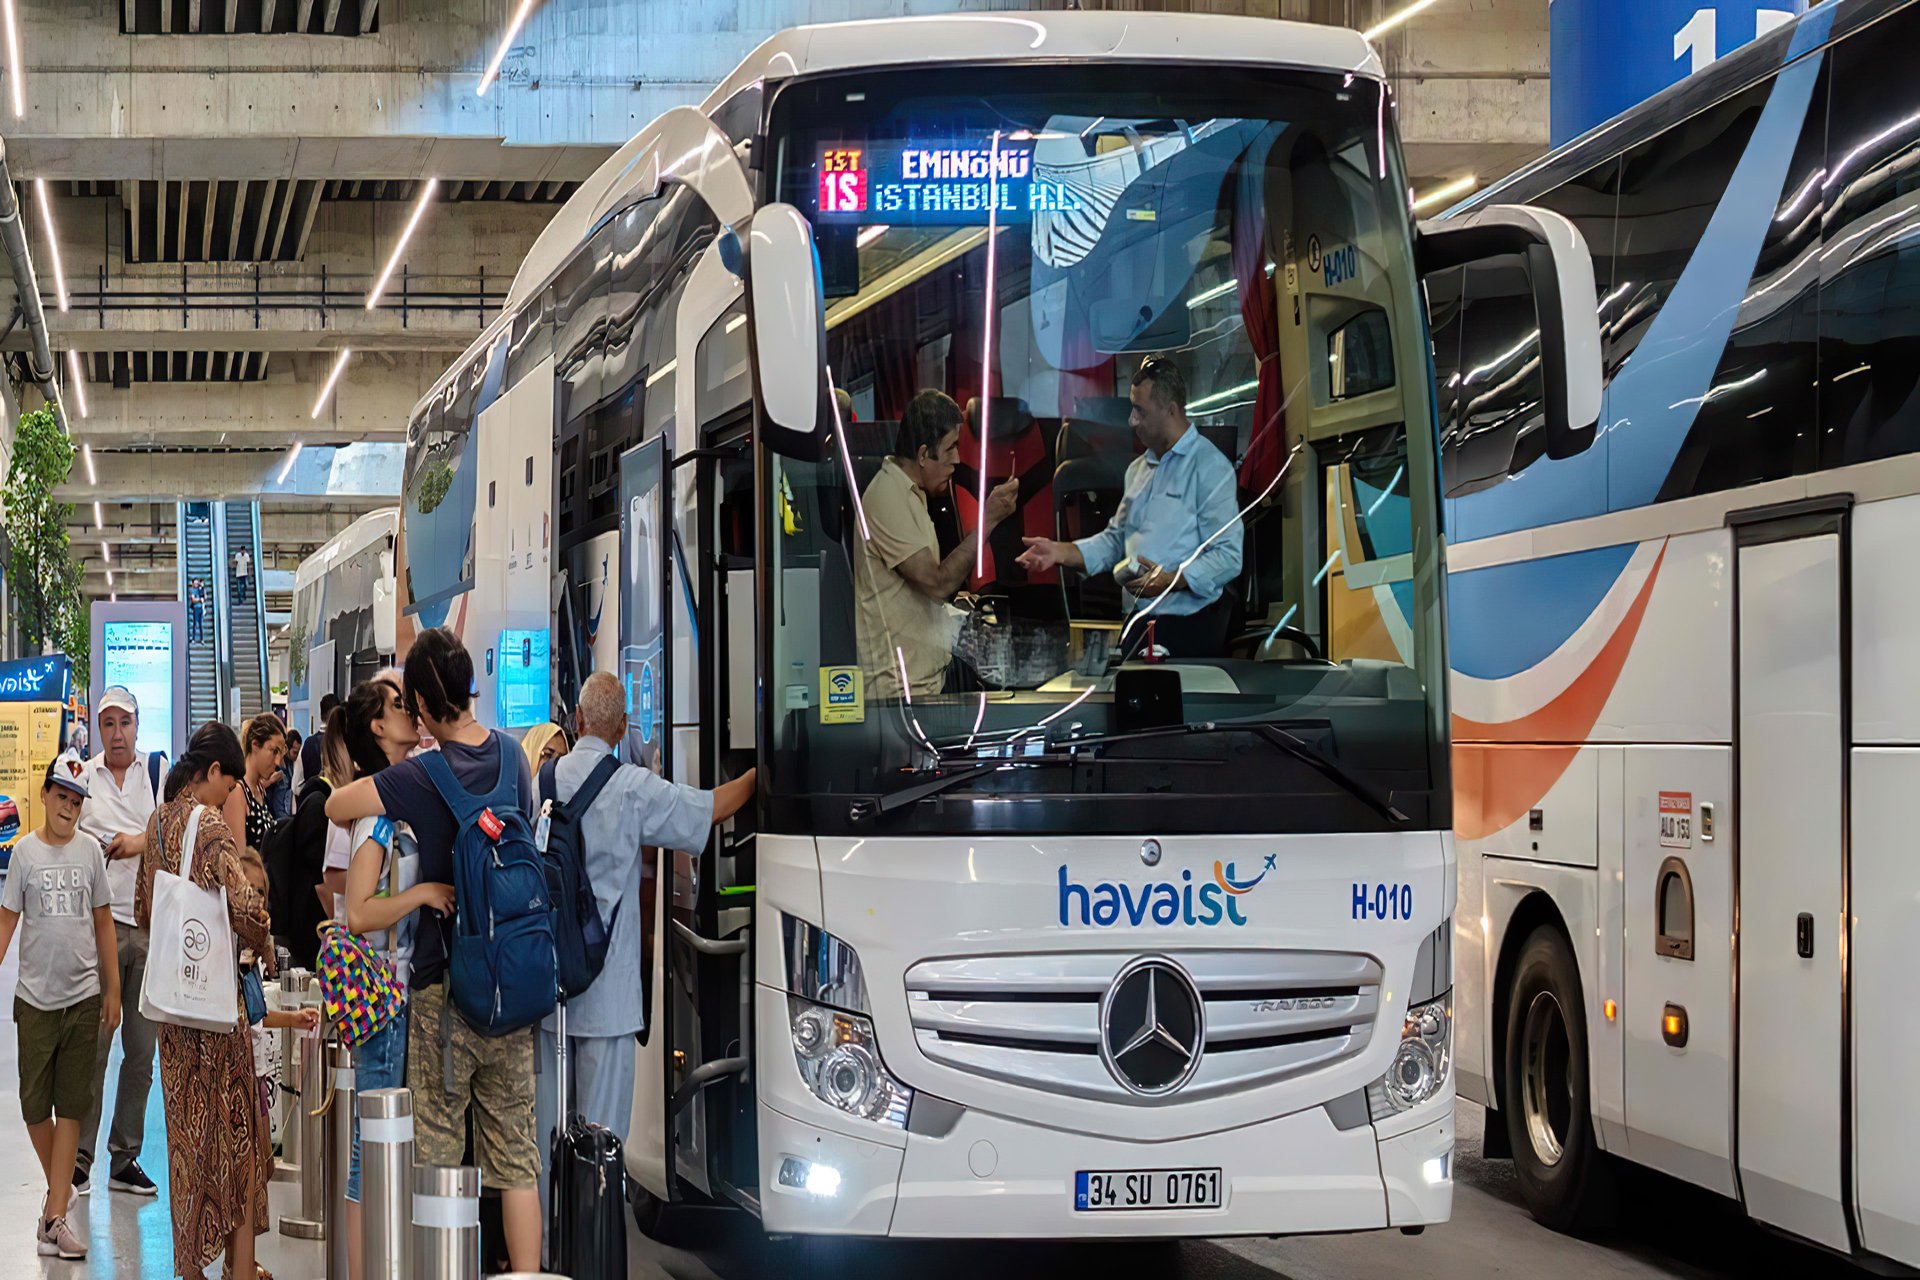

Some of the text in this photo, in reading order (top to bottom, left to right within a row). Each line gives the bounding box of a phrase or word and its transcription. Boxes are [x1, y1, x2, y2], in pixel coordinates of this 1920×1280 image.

[875, 184, 1017, 211] İSTANBUL
[1323, 245, 1356, 288] H-010
[1057, 859, 1262, 926] havaist
[1351, 883, 1413, 921] H-010
[1250, 997, 1336, 1012] TRAVEGO
[1090, 1173, 1218, 1206] 34 SU 0761
